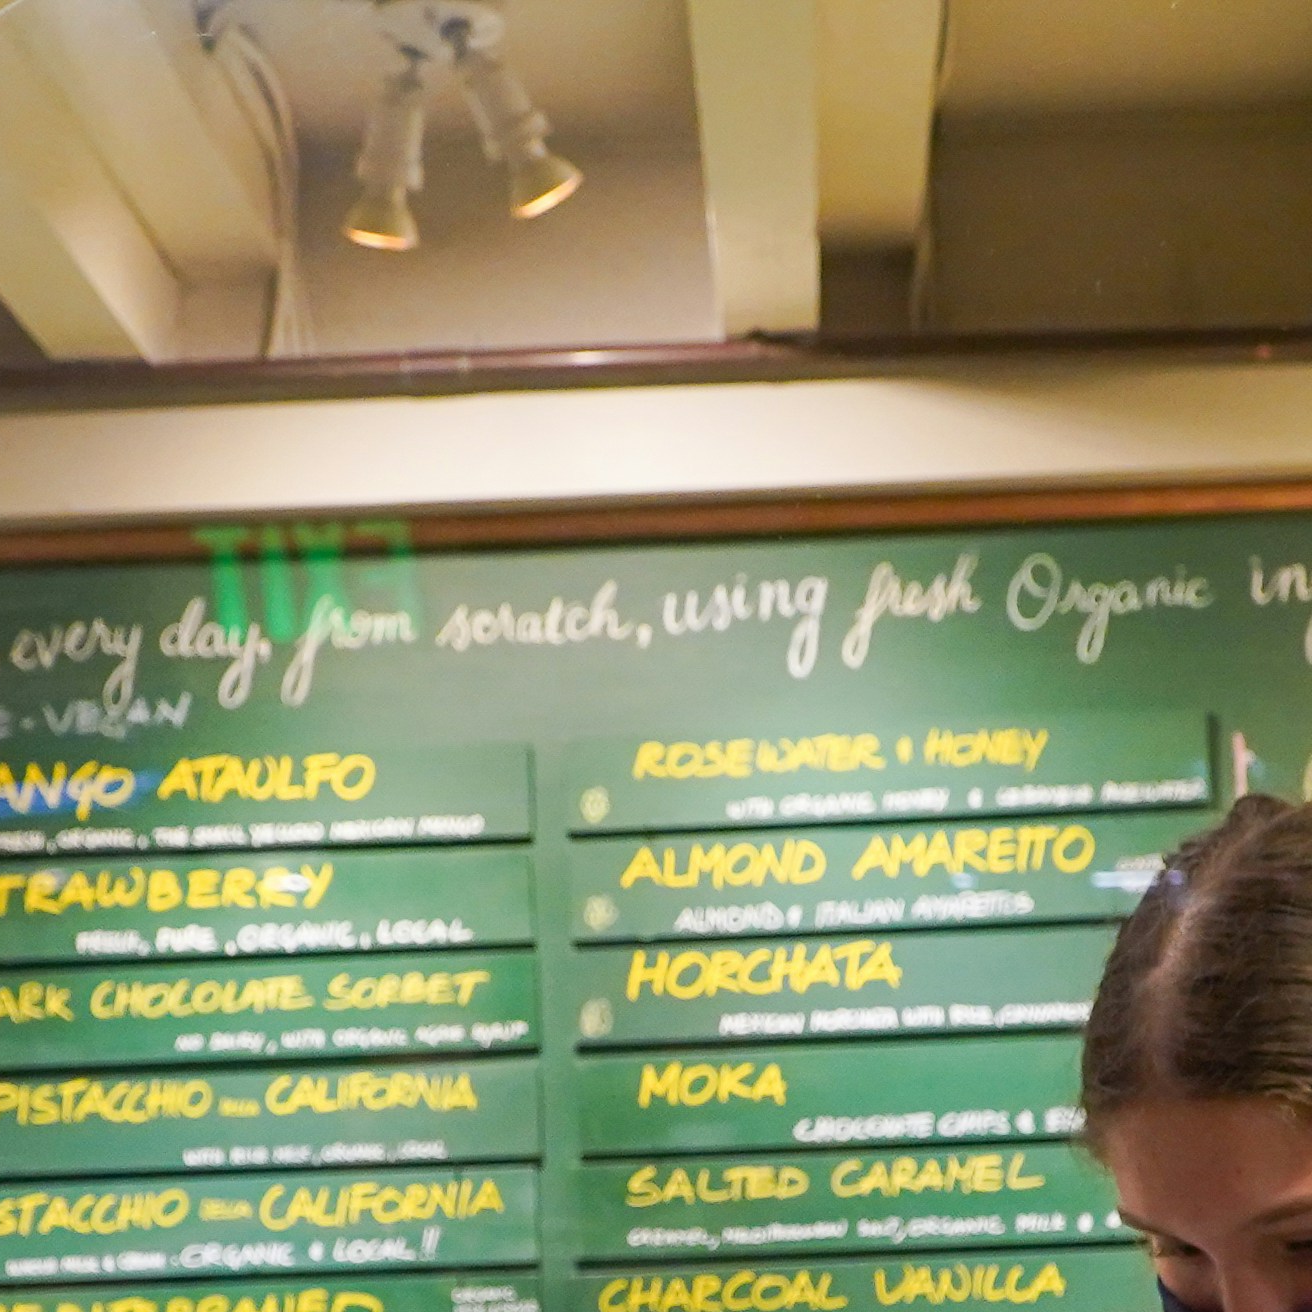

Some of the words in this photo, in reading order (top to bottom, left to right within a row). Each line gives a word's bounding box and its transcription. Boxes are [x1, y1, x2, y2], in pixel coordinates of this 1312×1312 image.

[11, 615, 142, 717] every
[281, 594, 418, 708] from
[662, 570, 828, 679] using
[841, 550, 982, 670] fresh
[1005, 552, 1212, 665] Organic
[923, 727, 1049, 773] HONEY
[156, 752, 377, 803] ATAULFO
[620, 838, 829, 891] ALMOND
[851, 824, 1097, 882] AMARETTO
[89, 973, 316, 1021] CHOCOLATE
[323, 969, 492, 1012] SORBET
[626, 940, 904, 1002] HORCHATA
[637, 1059, 788, 1109] MOKA
[258, 1176, 507, 1231] CALIFORNIA
[625, 1164, 810, 1209] SALTED
[829, 1152, 1045, 1199] CARAMEL
[873, 1262, 1067, 1305] VANILLA
